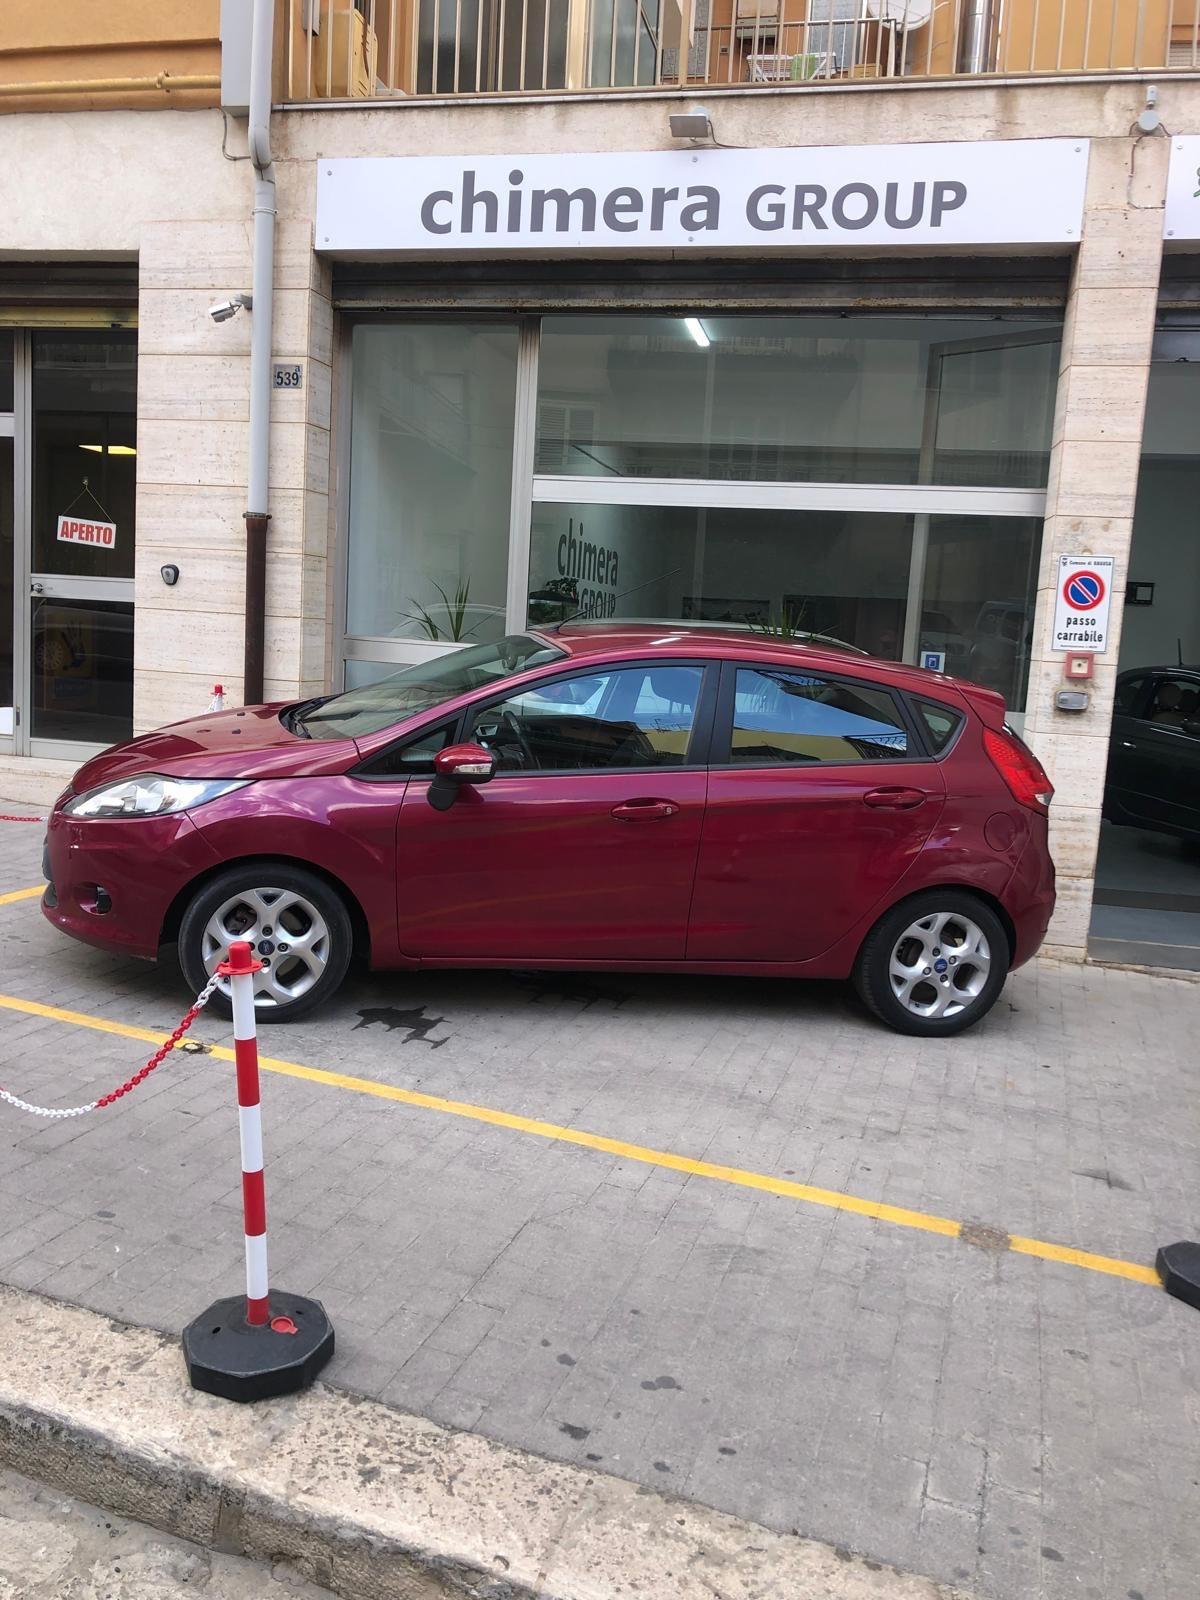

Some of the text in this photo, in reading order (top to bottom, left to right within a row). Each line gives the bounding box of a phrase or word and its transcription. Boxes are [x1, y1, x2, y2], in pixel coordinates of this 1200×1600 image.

[420, 169, 968, 235] chimera GROUP
[60, 520, 113, 545] APERTO
[557, 517, 619, 587] chimera
[580, 587, 616, 619] GROUP
[1056, 630, 1103, 642] carrabile
[1066, 616, 1097, 628] passo
